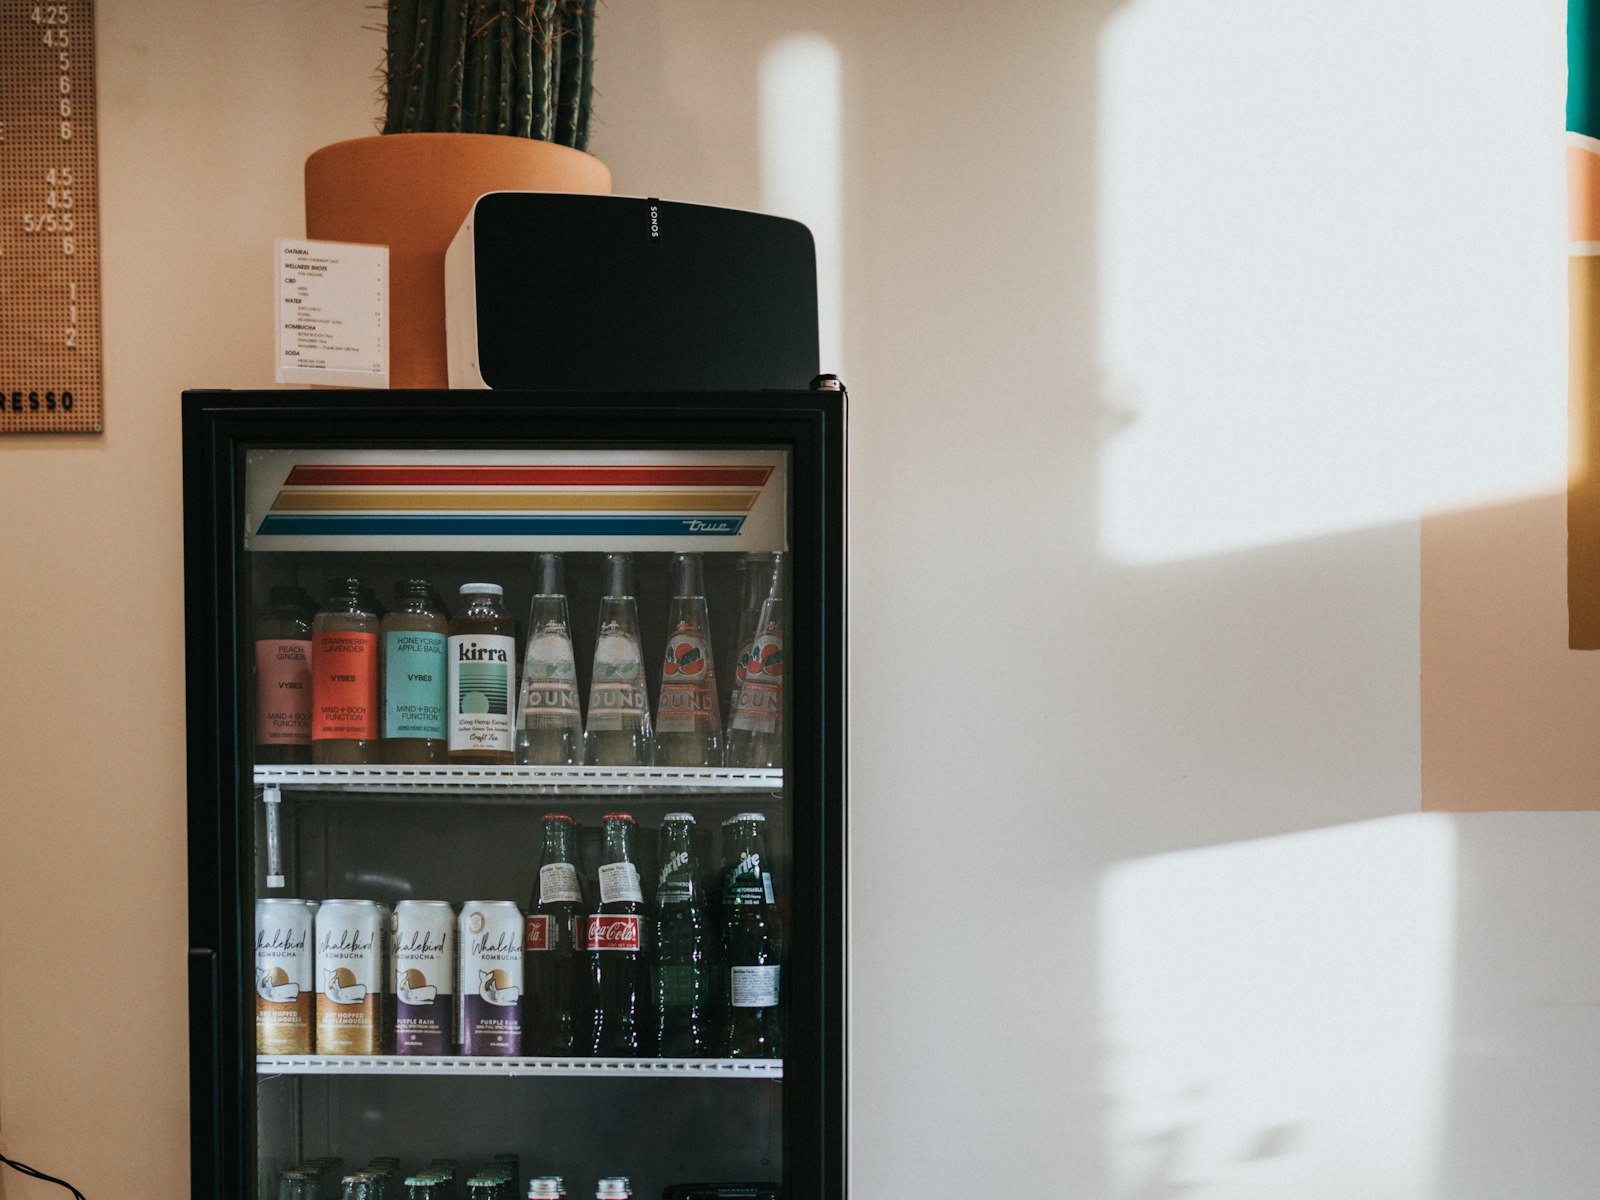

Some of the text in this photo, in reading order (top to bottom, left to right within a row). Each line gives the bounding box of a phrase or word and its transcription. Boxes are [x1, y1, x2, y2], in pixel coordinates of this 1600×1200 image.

[31, 6, 69, 24] 4.25
[43, 29, 69, 47] 4.5
[60, 52, 69, 70] 5
[60, 76, 70, 93] 6
[60, 99, 71, 117] 6
[61, 122, 72, 140] 6
[46, 167, 73, 186] 4.5
[46, 191, 73, 209] 4.5
[23, 214, 74, 232] 5/5.5
[650, 206, 659, 238] SONOS
[63, 237, 74, 255] 6
[70, 283, 76, 300] 1
[70, 306, 76, 323] 1
[66, 329, 76, 347] 2
[278, 645, 304, 653] PEACH
[321, 638, 368, 646] STRAWBERRY
[397, 637, 442, 646] HONEYCRISP
[277, 653, 305, 661] GINGER
[459, 642, 507, 662] kirra
[330, 674, 356, 682] VYBES
[407, 674, 433, 682] VYBES
[396, 706, 416, 714] MIND
[424, 706, 442, 714] BODY
[401, 713, 438, 721] FUNCTION
[731, 853, 760, 885] prite
[588, 921, 635, 941] Coca-Cola
[256, 929, 306, 952] halebird
